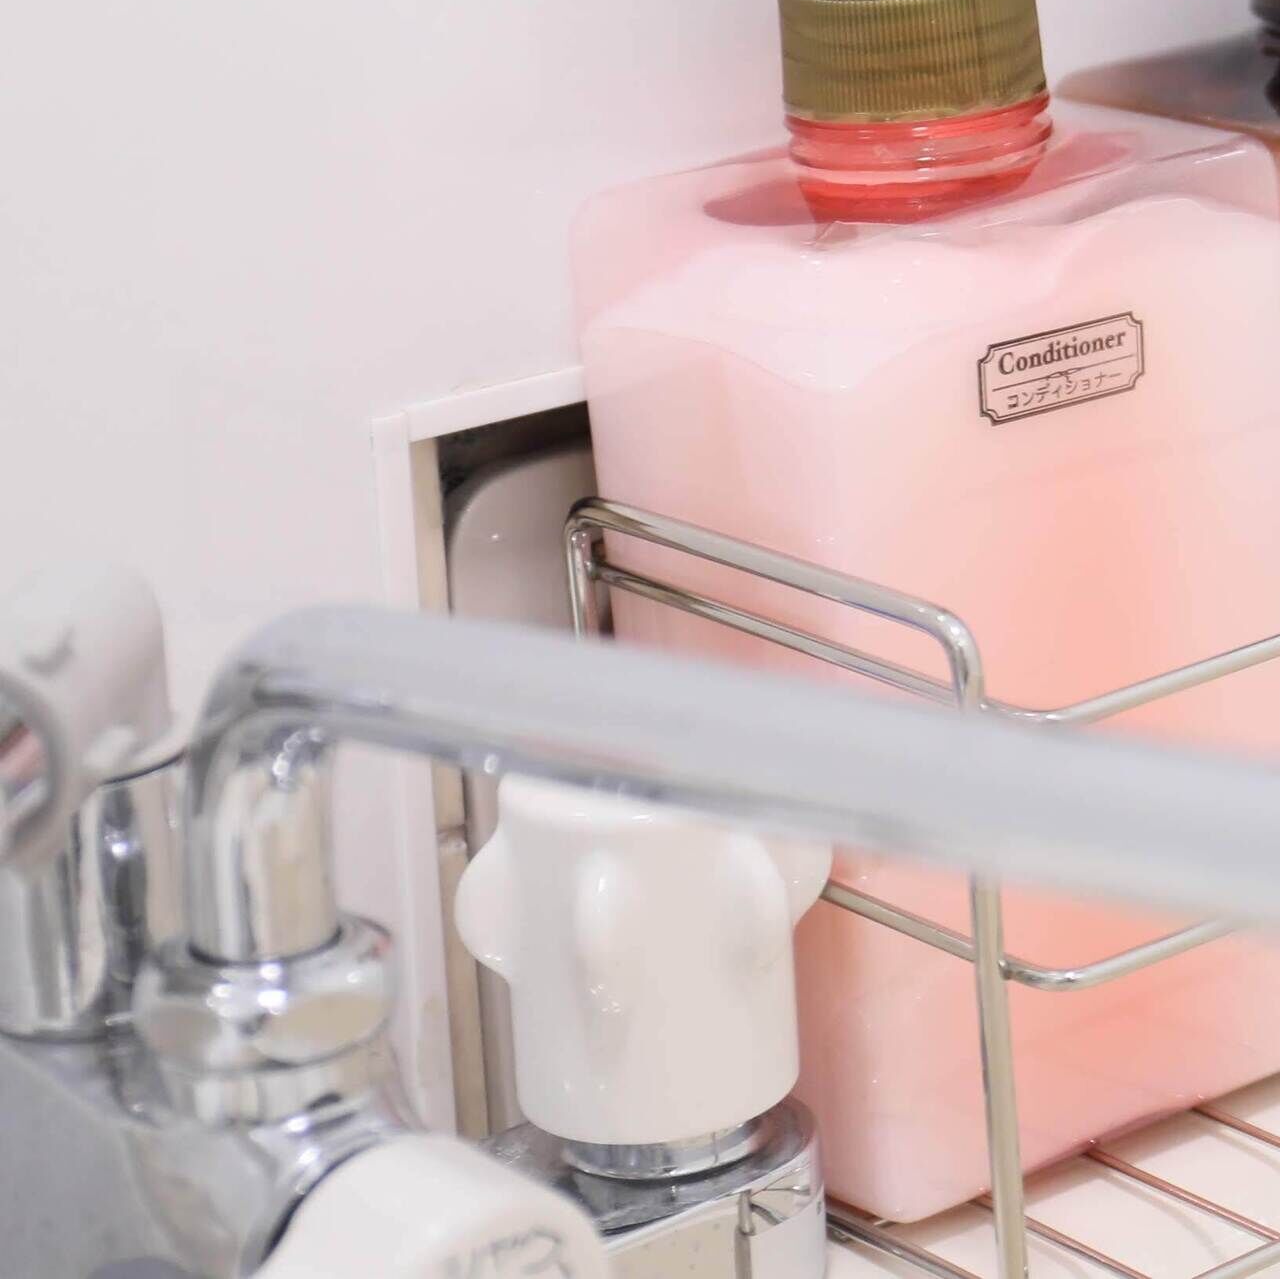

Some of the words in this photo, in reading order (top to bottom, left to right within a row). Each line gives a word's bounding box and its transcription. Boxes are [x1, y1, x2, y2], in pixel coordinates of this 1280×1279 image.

[998, 331, 1126, 375] Conditioner
[1007, 372, 1123, 410] コンディショナー
